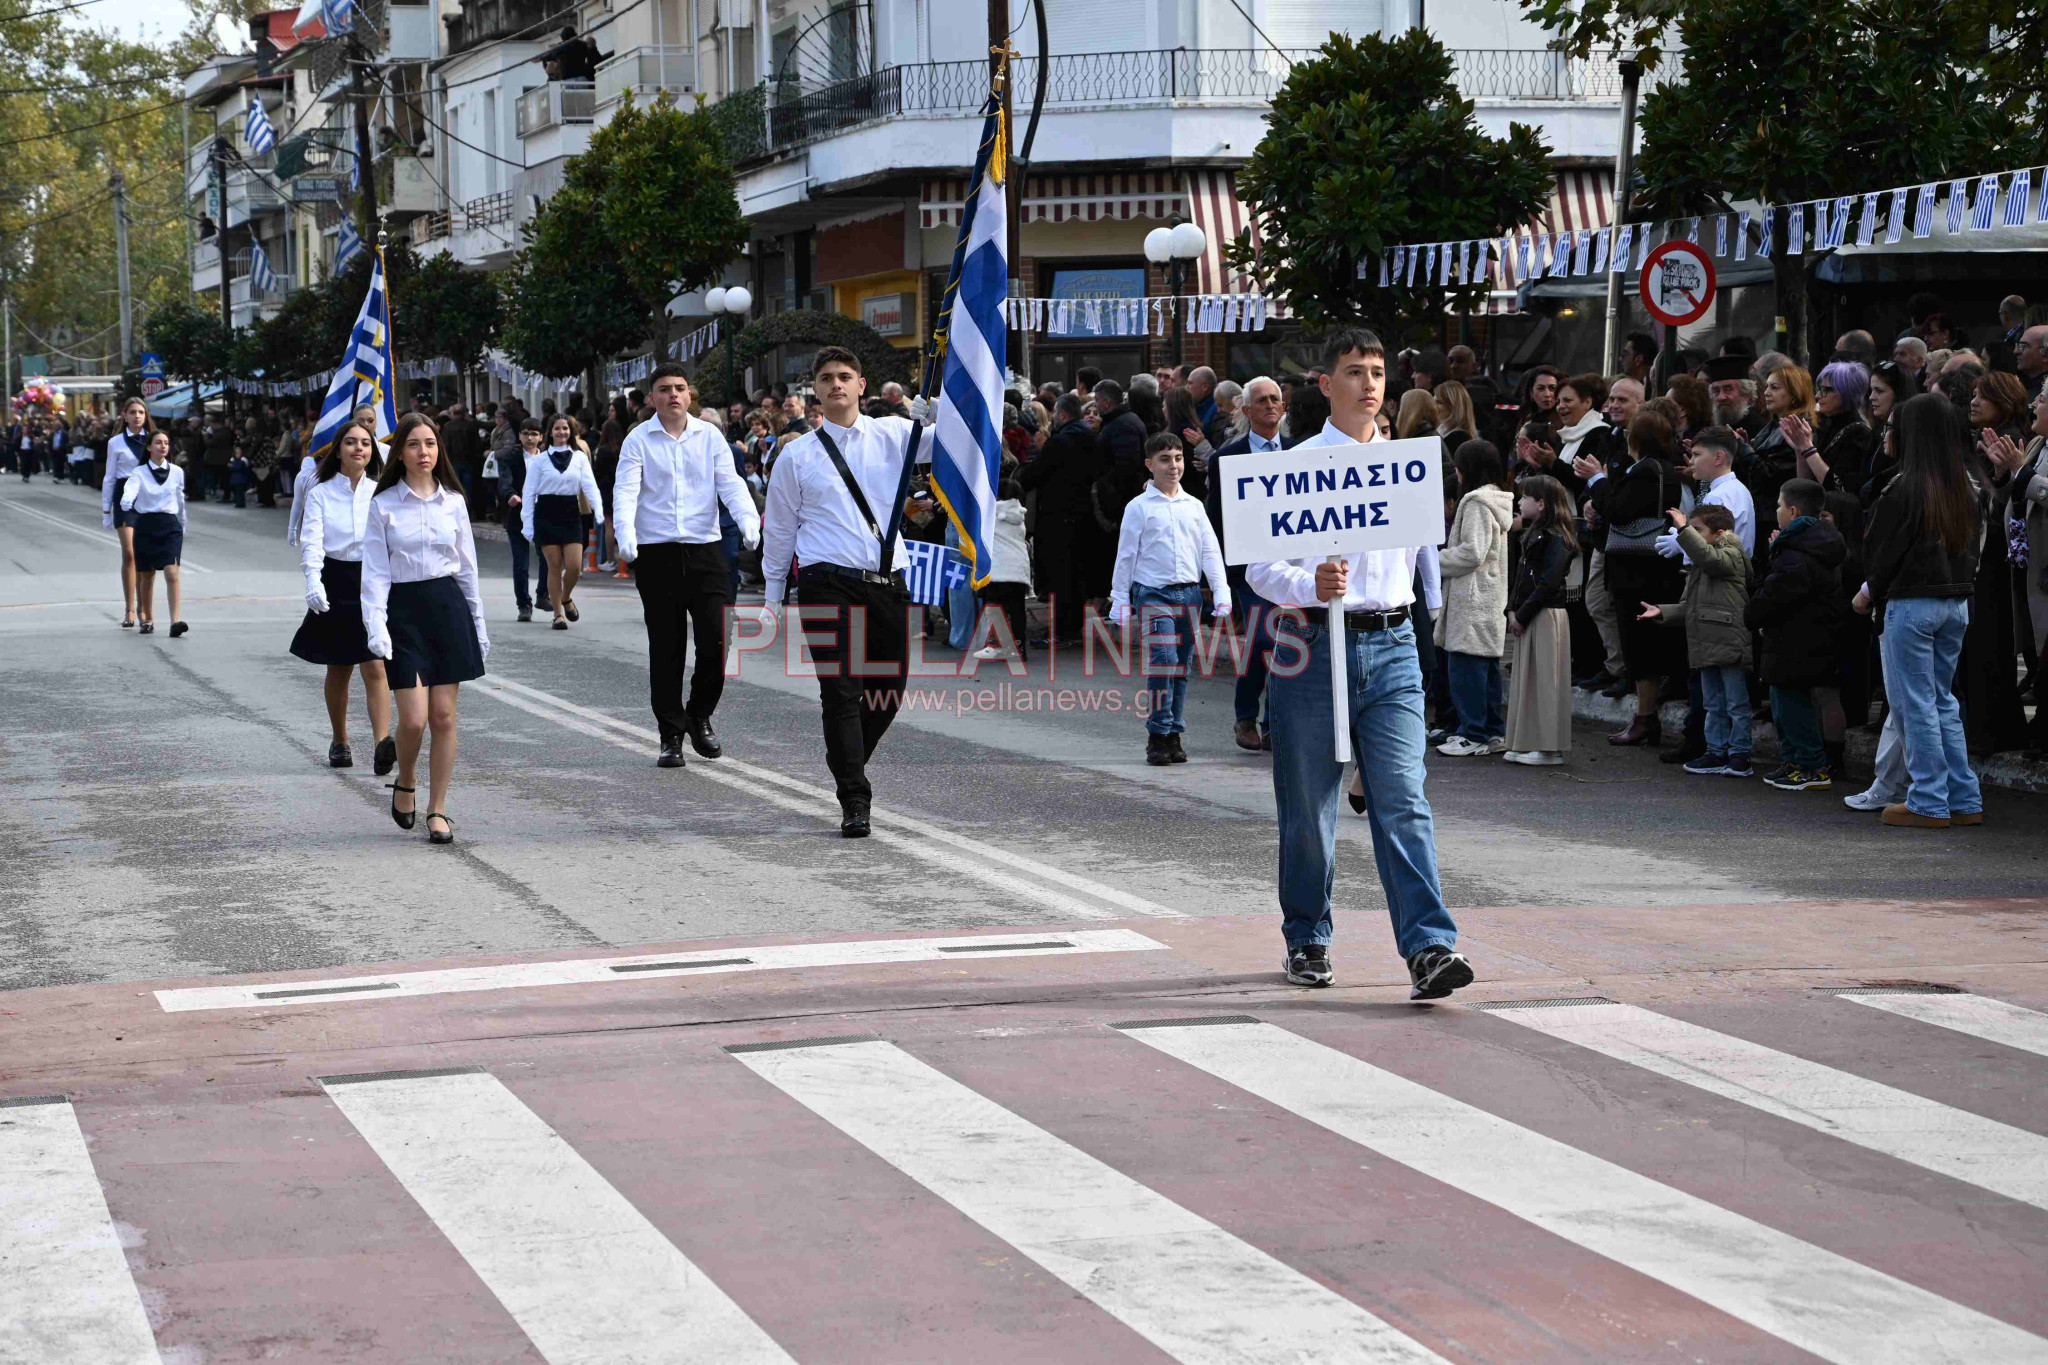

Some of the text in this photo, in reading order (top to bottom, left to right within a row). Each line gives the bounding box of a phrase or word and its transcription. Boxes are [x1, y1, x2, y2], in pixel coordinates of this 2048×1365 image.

[143, 382, 162, 394] STOP
[1237, 460, 1427, 500] ΓΥΜΝΑΣΙΟ
[1271, 501, 1389, 537] ΚΑΛΗΣ
